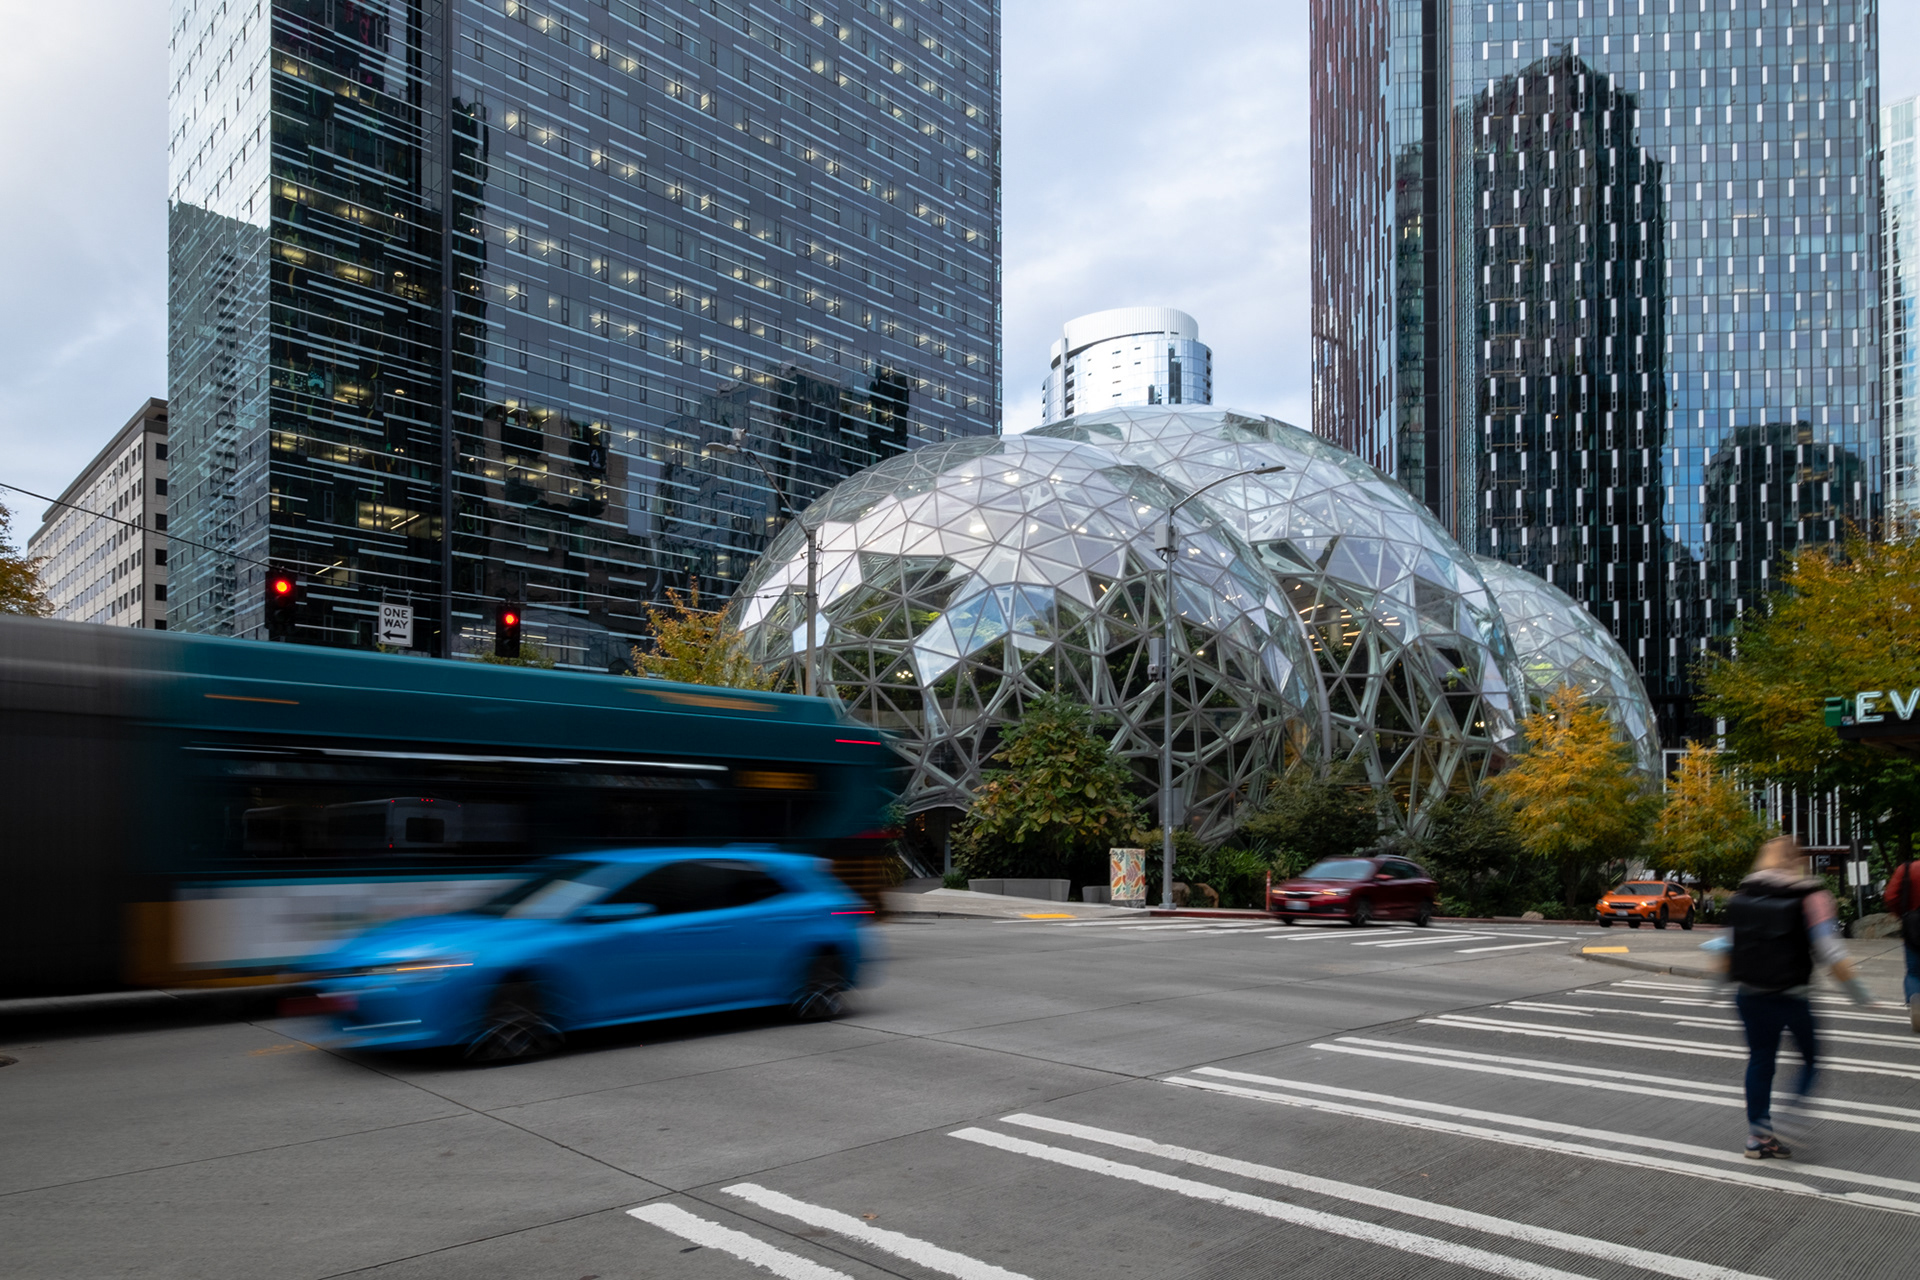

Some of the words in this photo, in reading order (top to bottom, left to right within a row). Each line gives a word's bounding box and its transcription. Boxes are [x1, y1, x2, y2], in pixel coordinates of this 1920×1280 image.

[384, 607, 408, 619] ONE
[384, 618, 408, 629] WAY
[1856, 687, 1920, 723] EV
